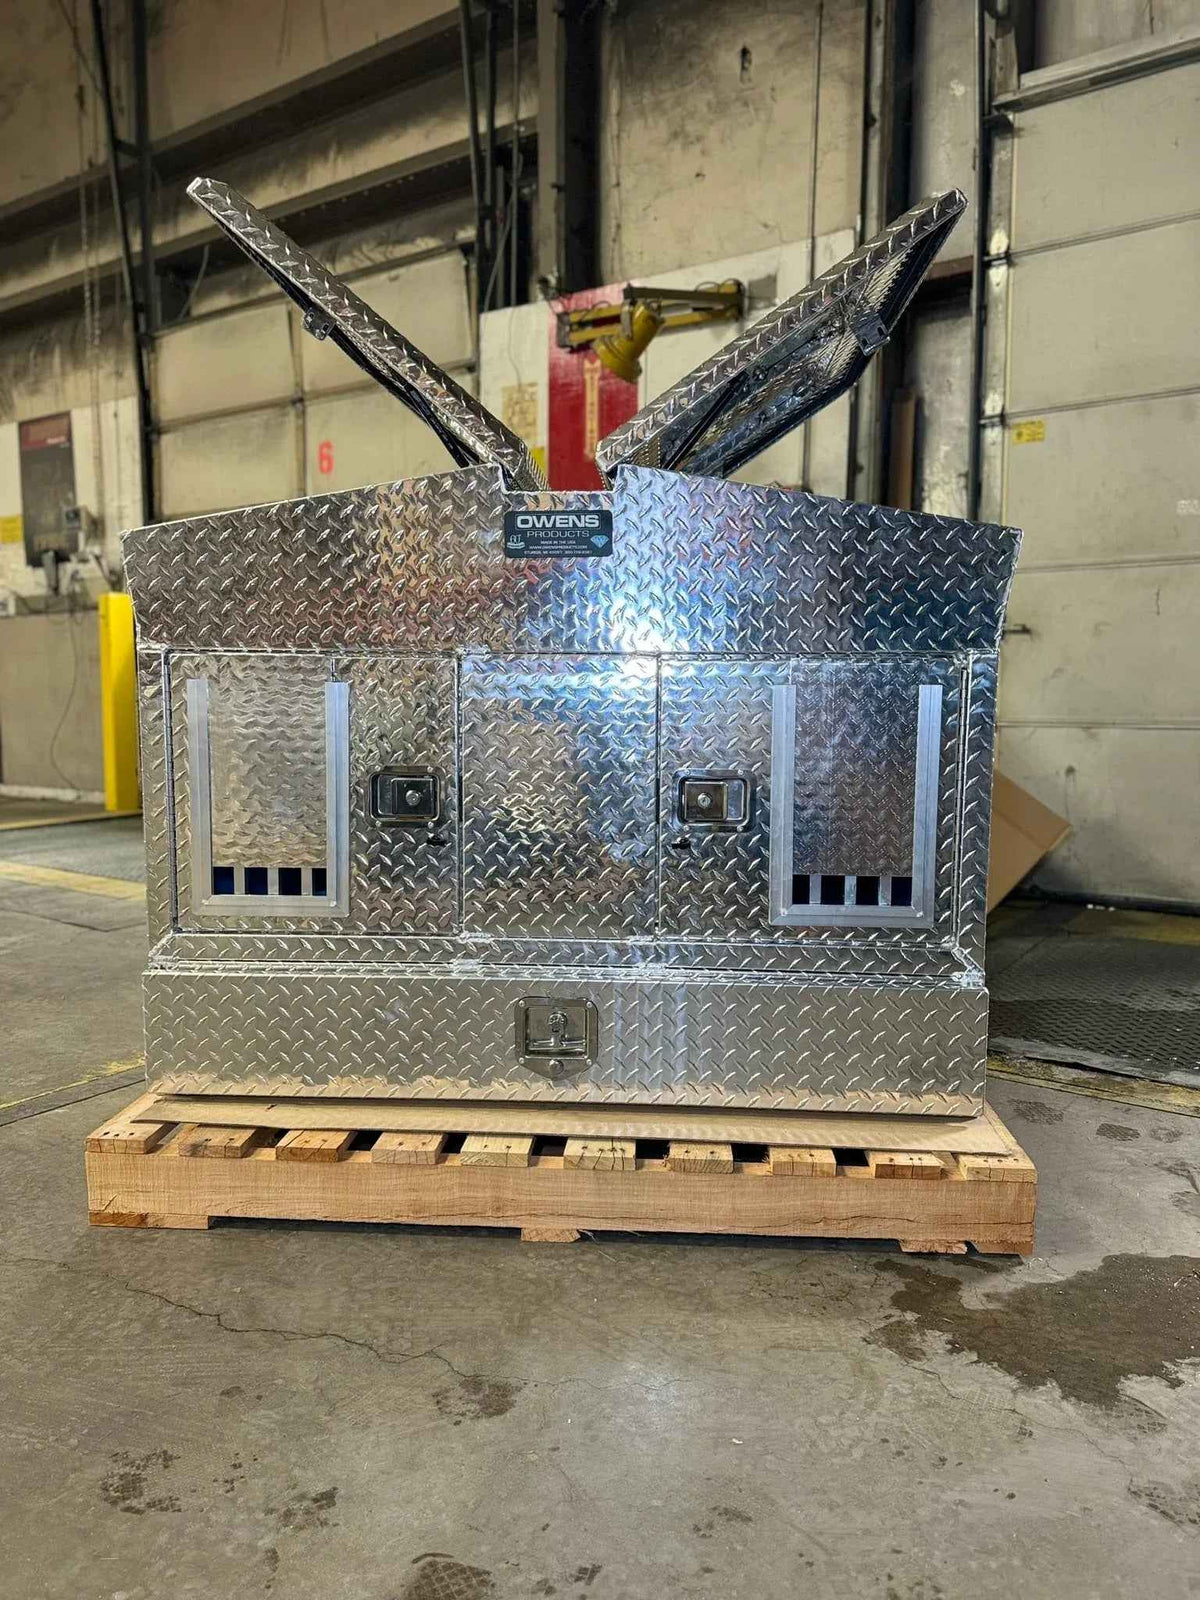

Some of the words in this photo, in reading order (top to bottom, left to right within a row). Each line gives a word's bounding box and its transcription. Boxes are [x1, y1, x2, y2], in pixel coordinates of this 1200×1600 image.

[317, 440, 335, 475] 6
[517, 515, 599, 528] OWENS
[526, 530, 590, 538] PRODUCTS
